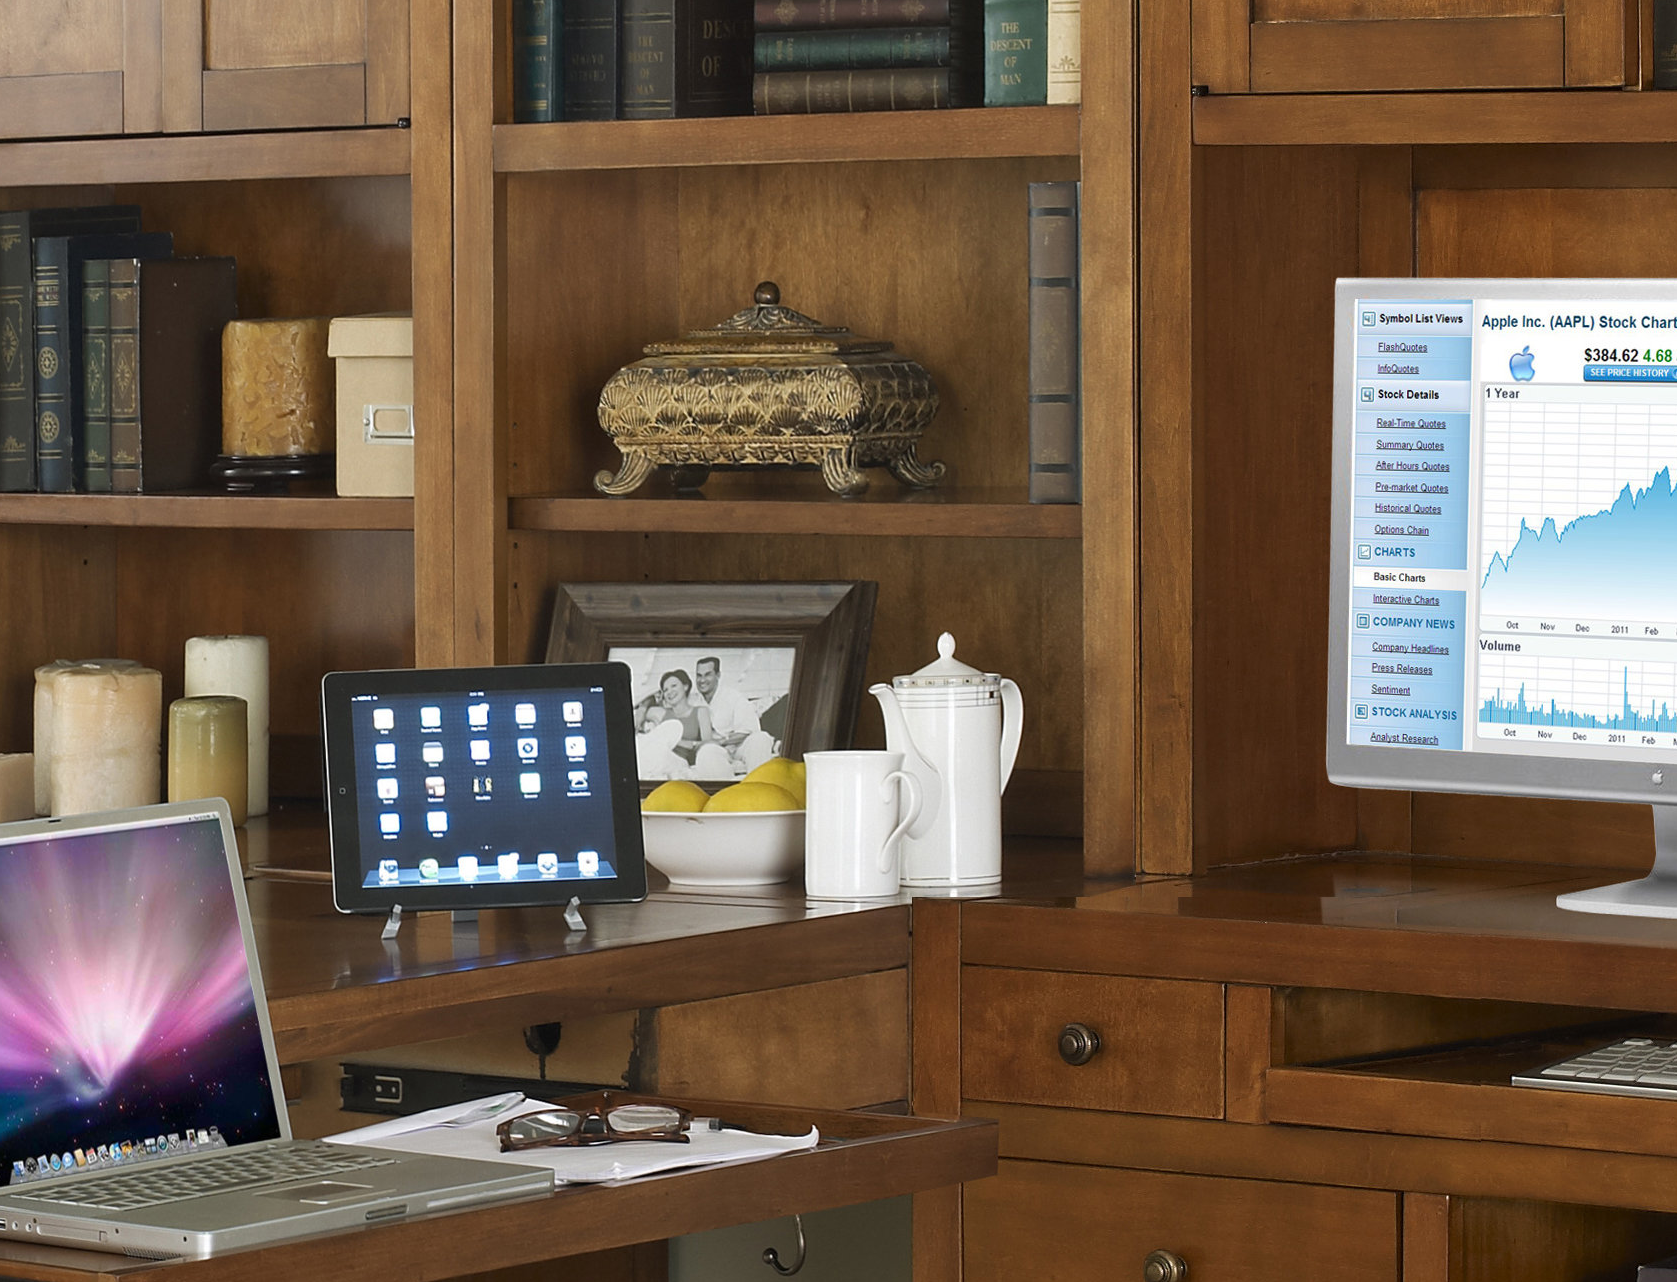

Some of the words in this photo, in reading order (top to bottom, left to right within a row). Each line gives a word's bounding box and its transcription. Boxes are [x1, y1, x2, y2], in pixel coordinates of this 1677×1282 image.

[1001, 22, 1019, 34] THE
[990, 38, 1032, 52] DESCENT
[702, 55, 721, 77] OF
[1004, 56, 1017, 67] OF
[1001, 73, 1021, 86] MAN
[1380, 314, 1413, 325] Symbol
[1416, 314, 1433, 323] List
[1435, 314, 1463, 323] Views
[1482, 315, 1518, 329] Apple
[1522, 316, 1545, 328] Inc.
[1550, 316, 1595, 330] (AAPL)
[1599, 316, 1637, 328] Stock
[1378, 342, 1428, 353] FlashQuotes
[1584, 348, 1638, 362] $384.62
[1642, 349, 1672, 362] 4.68
[1378, 364, 1419, 374] InfoQuotes
[1591, 368, 1605, 376] SEE
[1607, 368, 1631, 377] PRICE
[1633, 369, 1670, 377] HISTORY
[1378, 389, 1404, 399] Stock
[1407, 390, 1439, 399] Details
[1486, 389, 1490, 398] 1
[1495, 388, 1519, 398] Year
[1377, 418, 1415, 428] Real-Time
[1418, 419, 1446, 429] Quotes
[1376, 440, 1414, 451] Summary
[1416, 441, 1444, 451] Quotes
[1376, 461, 1394, 471] After
[1396, 461, 1419, 471] Hours
[1422, 462, 1450, 472] Quotes
[1376, 482, 1418, 493] Pre-market
[1420, 483, 1449, 494] Quotes
[1375, 503, 1411, 514] Historical
[1414, 504, 1442, 515] Quotes
[1374, 525, 1404, 535] Options
[1407, 526, 1429, 536] Chain
[1374, 547, 1415, 557] CHARTS
[1374, 572, 1396, 581] Basic
[1399, 573, 1426, 582] Charts
[1373, 594, 1412, 605] Interactive
[1414, 595, 1440, 606] Charts
[1373, 617, 1423, 628] COMPANY
[1426, 619, 1455, 629] NEWS
[1372, 642, 1409, 654] Company
[1411, 644, 1449, 655] Headlines
[1480, 639, 1521, 651] Volume
[1372, 663, 1394, 674] Press
[1397, 664, 1433, 675] Releases
[1371, 684, 1410, 696] Sentiment
[1372, 707, 1407, 717] STOCK
[1409, 709, 1457, 720] ANALYSIS
[1370, 732, 1399, 743] Analyst
[1403, 734, 1439, 746] Research
